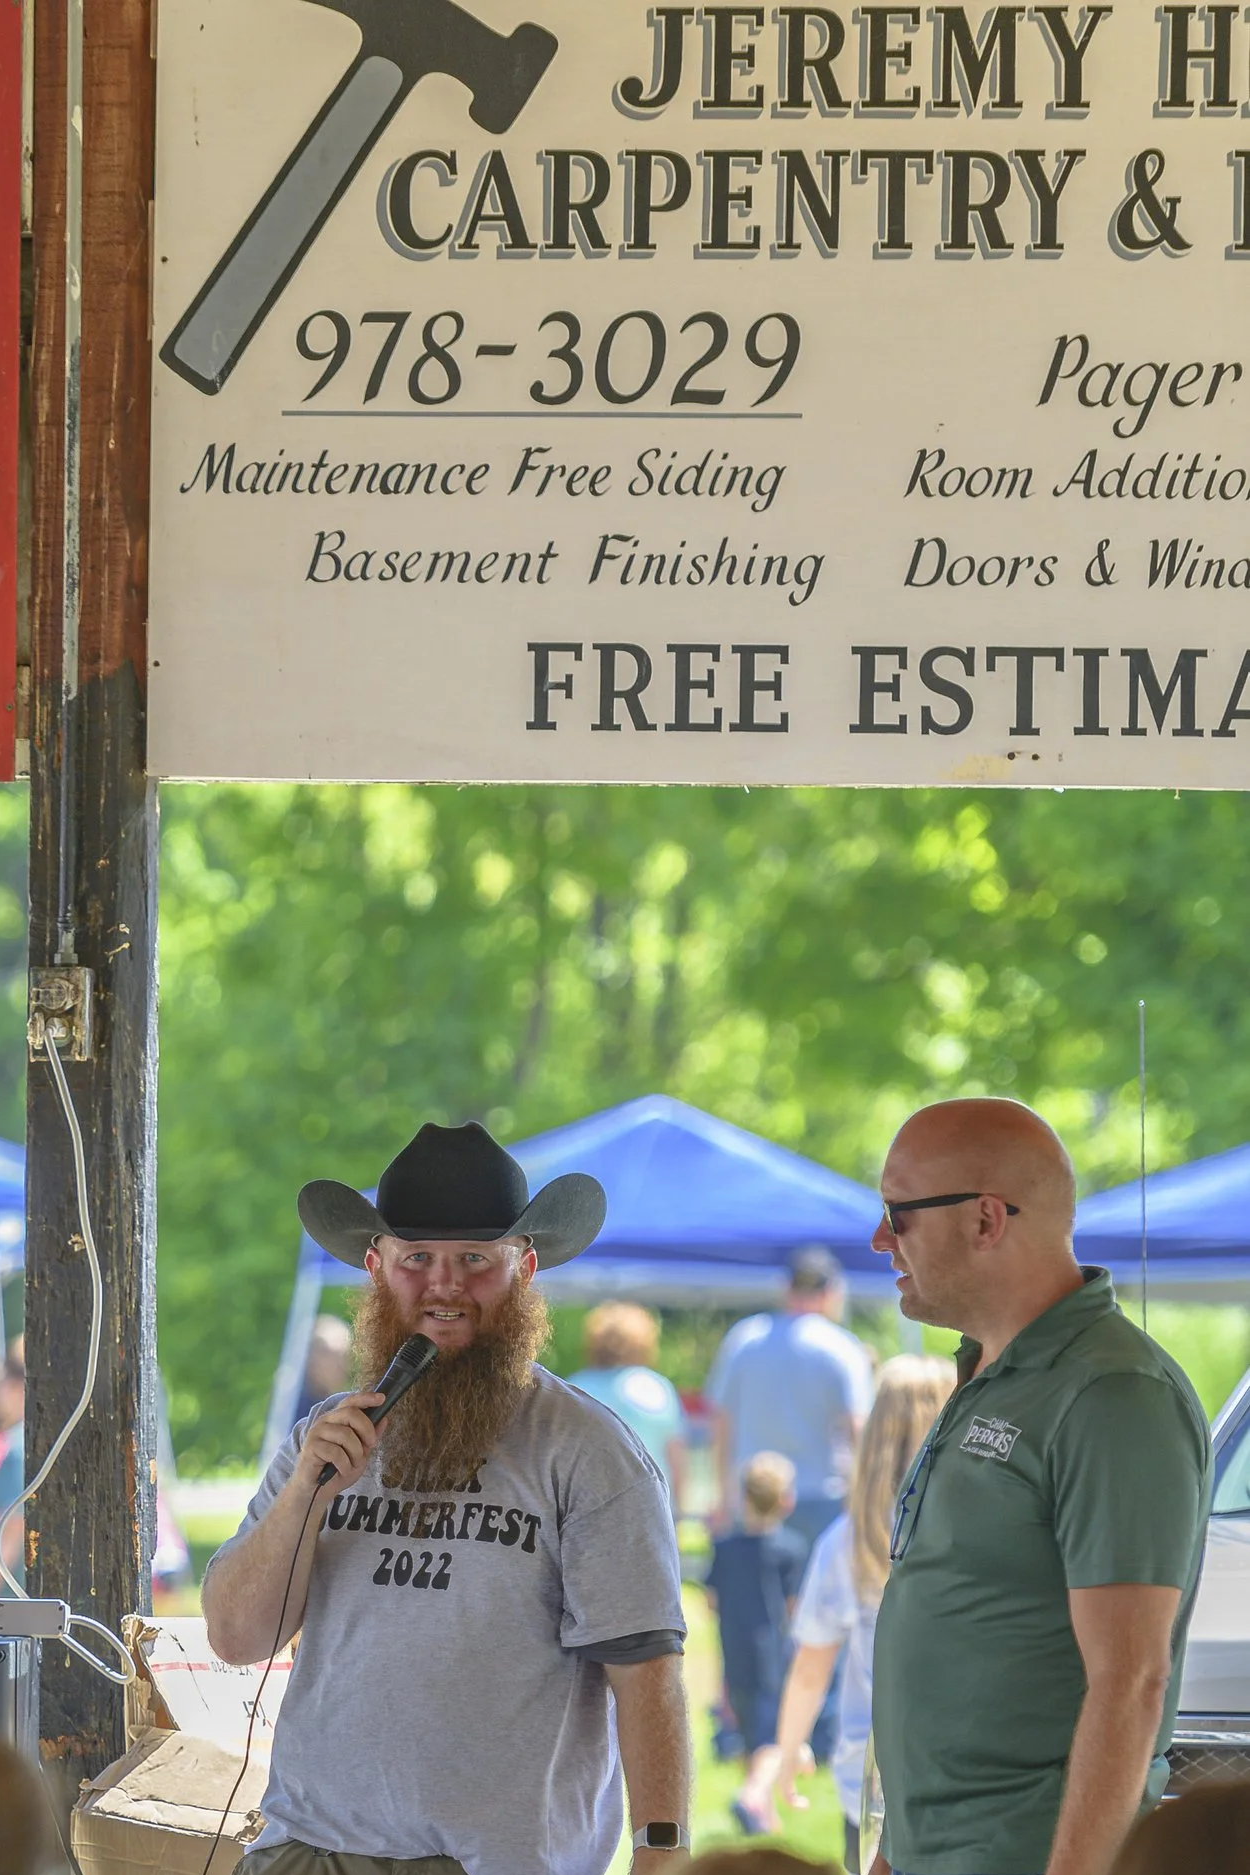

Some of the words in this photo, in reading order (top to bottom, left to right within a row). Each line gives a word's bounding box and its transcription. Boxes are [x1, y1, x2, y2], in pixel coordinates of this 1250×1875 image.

[613, 6, 1113, 120] JEREMY
[1152, 5, 1250, 118] H
[376, 148, 1086, 261] CARPENTRY
[1107, 148, 1193, 261] &
[294, 309, 803, 406] 978-3029
[1036, 333, 1243, 438] Pager
[179, 442, 489, 497] Maintenance
[506, 446, 612, 498] Free
[628, 447, 787, 511] Siding
[905, 449, 1034, 500] Room
[1052, 449, 1250, 501] Additio
[305, 530, 561, 584] Basement
[588, 533, 825, 606] Finishing
[904, 537, 1057, 588] Doors
[1085, 538, 1119, 587] &
[526, 641, 790, 732] FREE
[318, 1494, 542, 1554] UMMERFEST
[372, 1548, 453, 1591] 2022
